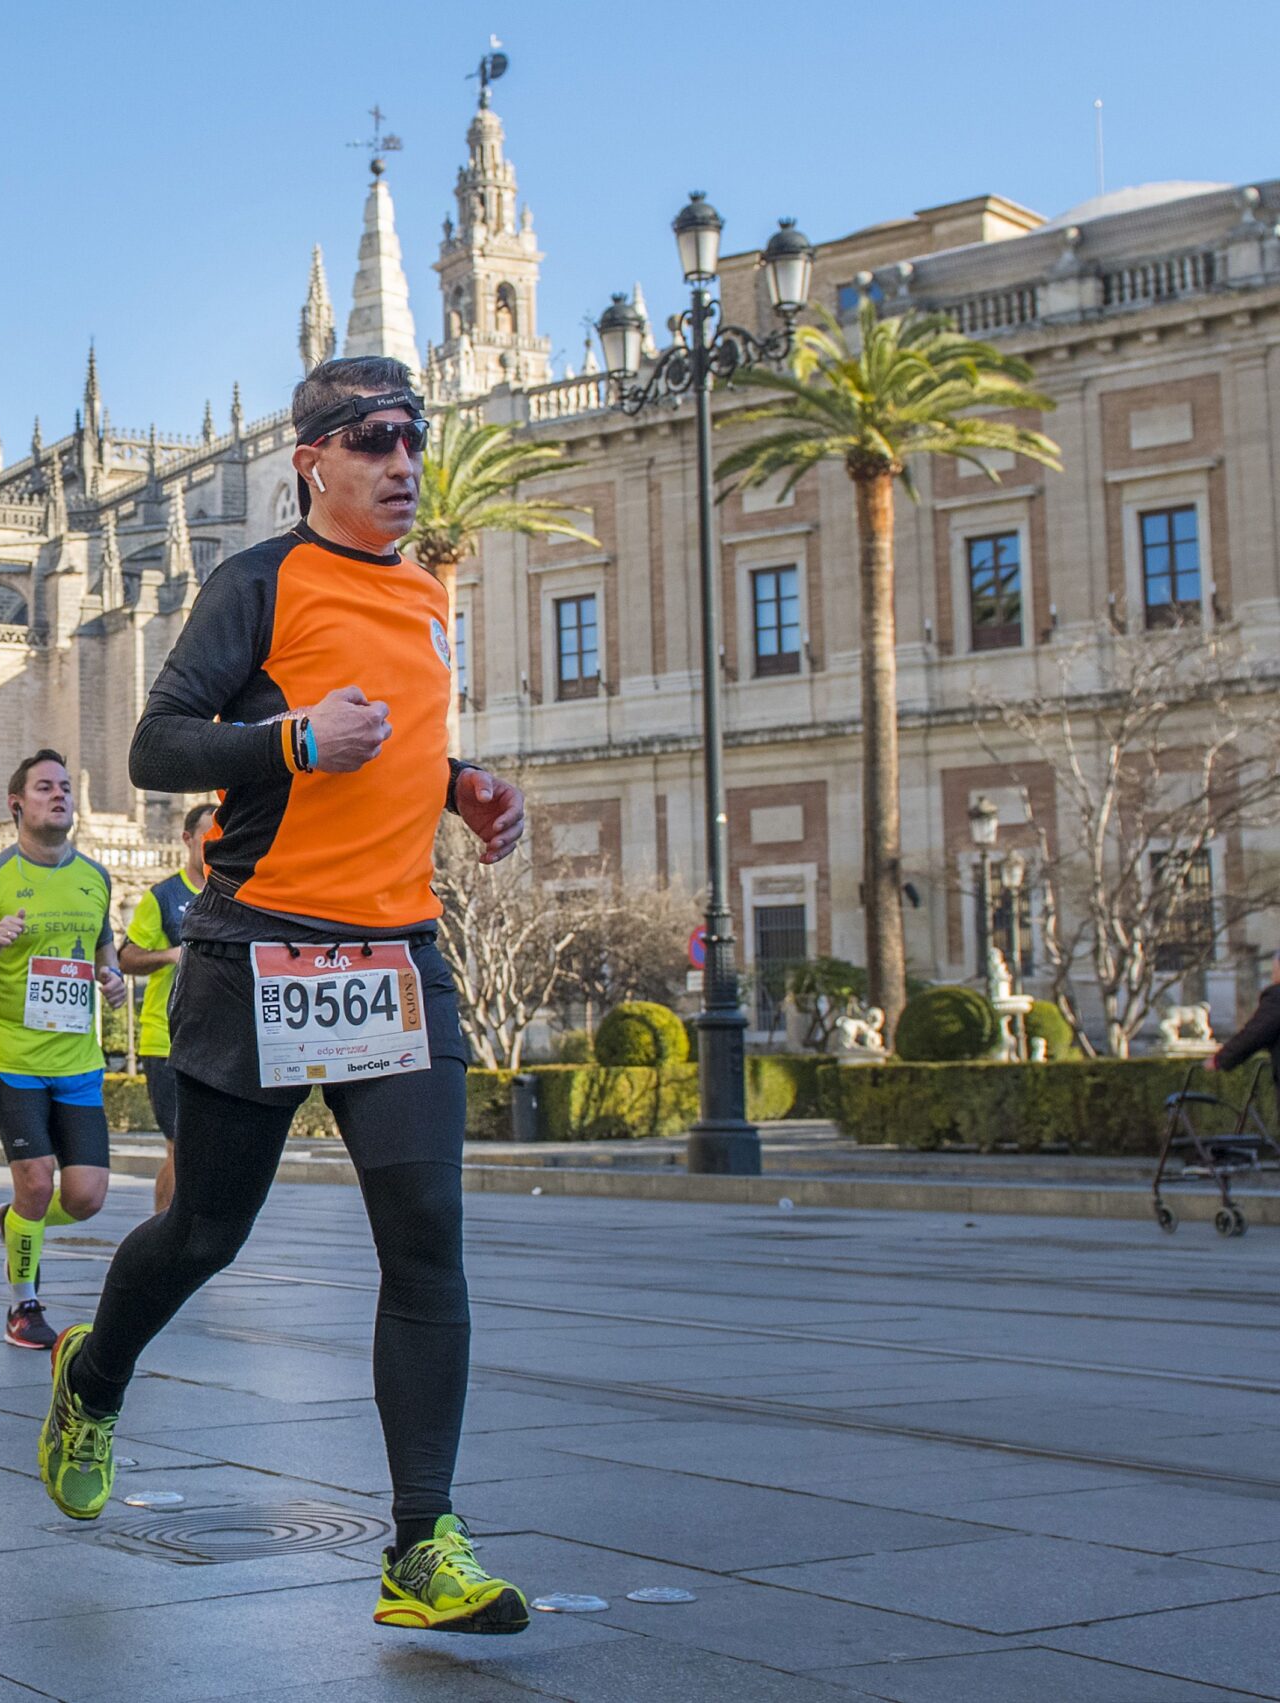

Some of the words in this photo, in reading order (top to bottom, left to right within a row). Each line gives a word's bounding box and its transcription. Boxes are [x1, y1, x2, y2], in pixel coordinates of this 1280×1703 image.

[16, 887, 34, 898] edp
[24, 923, 39, 935] DE
[45, 922, 96, 933] SEVILLA
[314, 950, 352, 971] edp
[60, 963, 79, 977] edp
[41, 980, 88, 1007] 5598
[283, 975, 397, 1029] 9564
